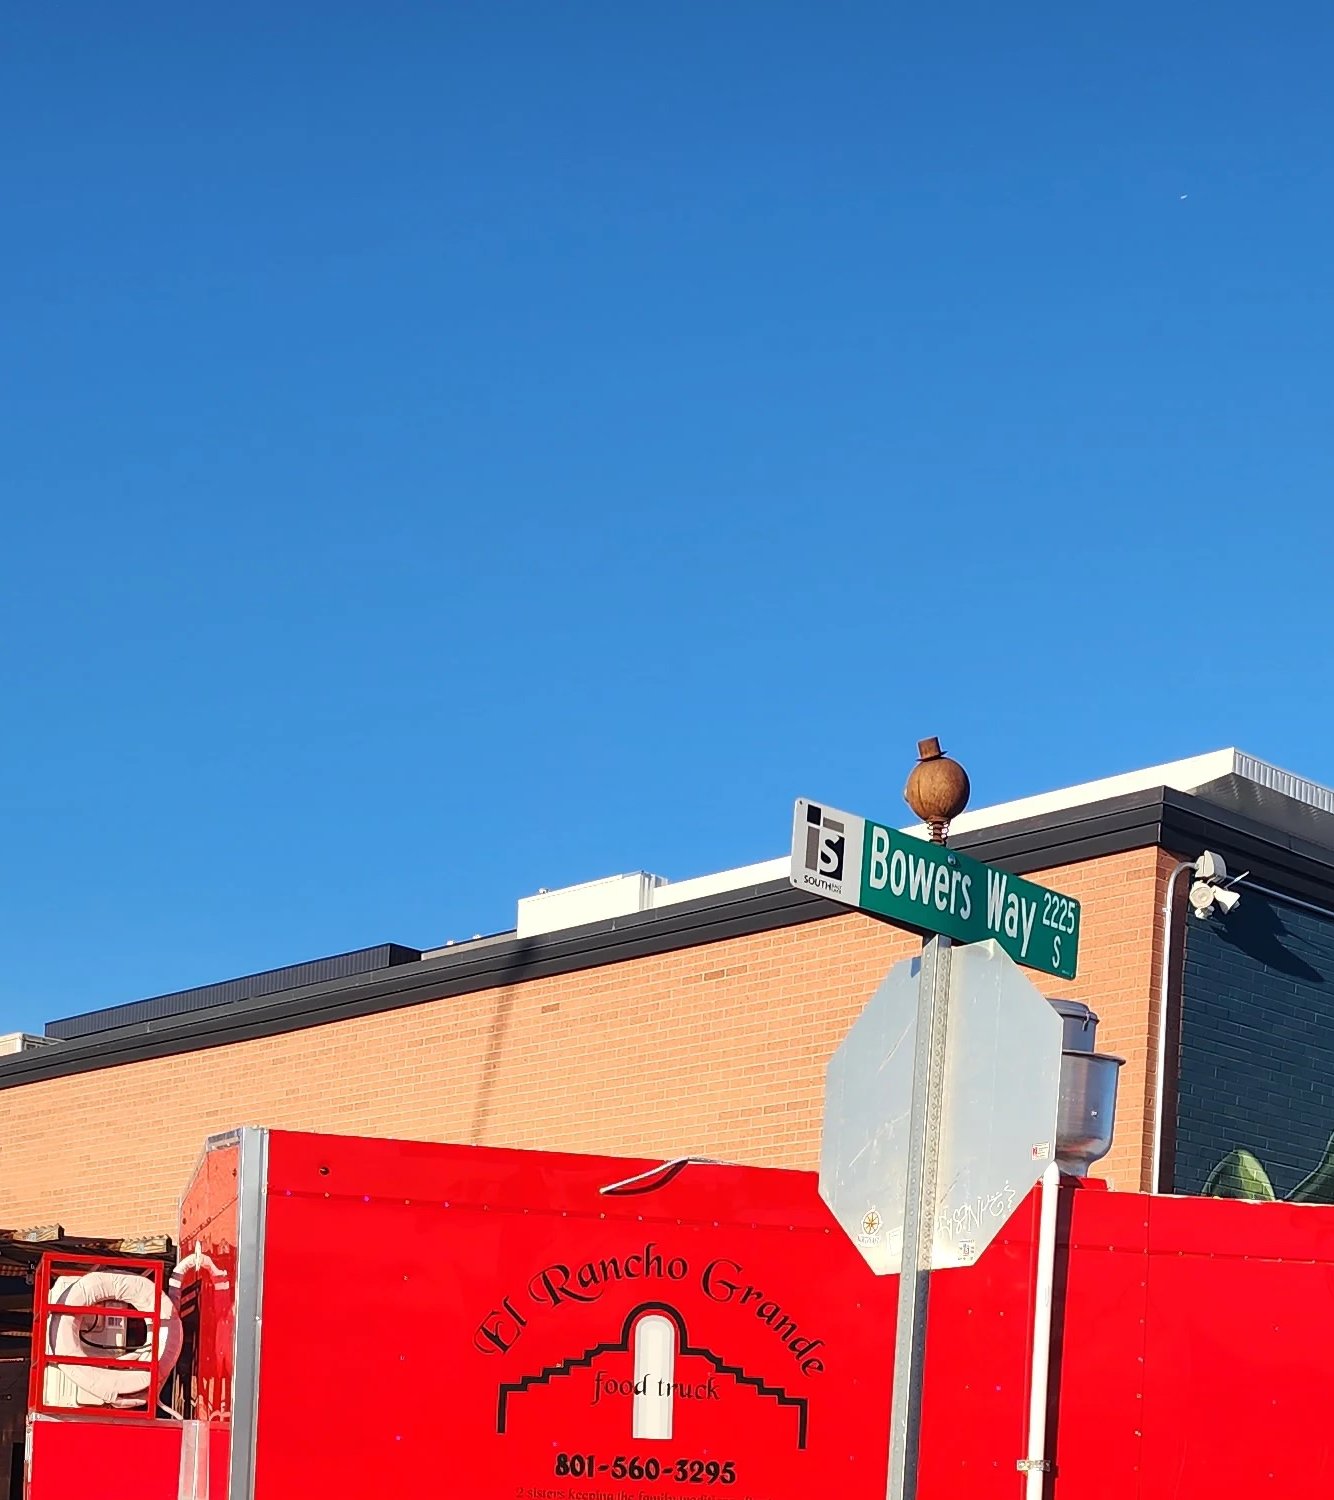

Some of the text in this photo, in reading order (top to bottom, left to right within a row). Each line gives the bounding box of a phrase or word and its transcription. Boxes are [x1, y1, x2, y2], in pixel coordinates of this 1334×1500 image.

[803, 874, 832, 891] SOUTH
[869, 825, 1037, 957] Bowers Way
[1042, 891, 1075, 934] 2225
[1051, 935, 1061, 968] S
[472, 1243, 827, 1378] El Rancho Grande
[590, 1371, 720, 1406] food truck
[555, 1453, 737, 1485] 801-560-3295
[516, 1487, 524, 1498] 2
[527, 1487, 566, 1500] sisters
